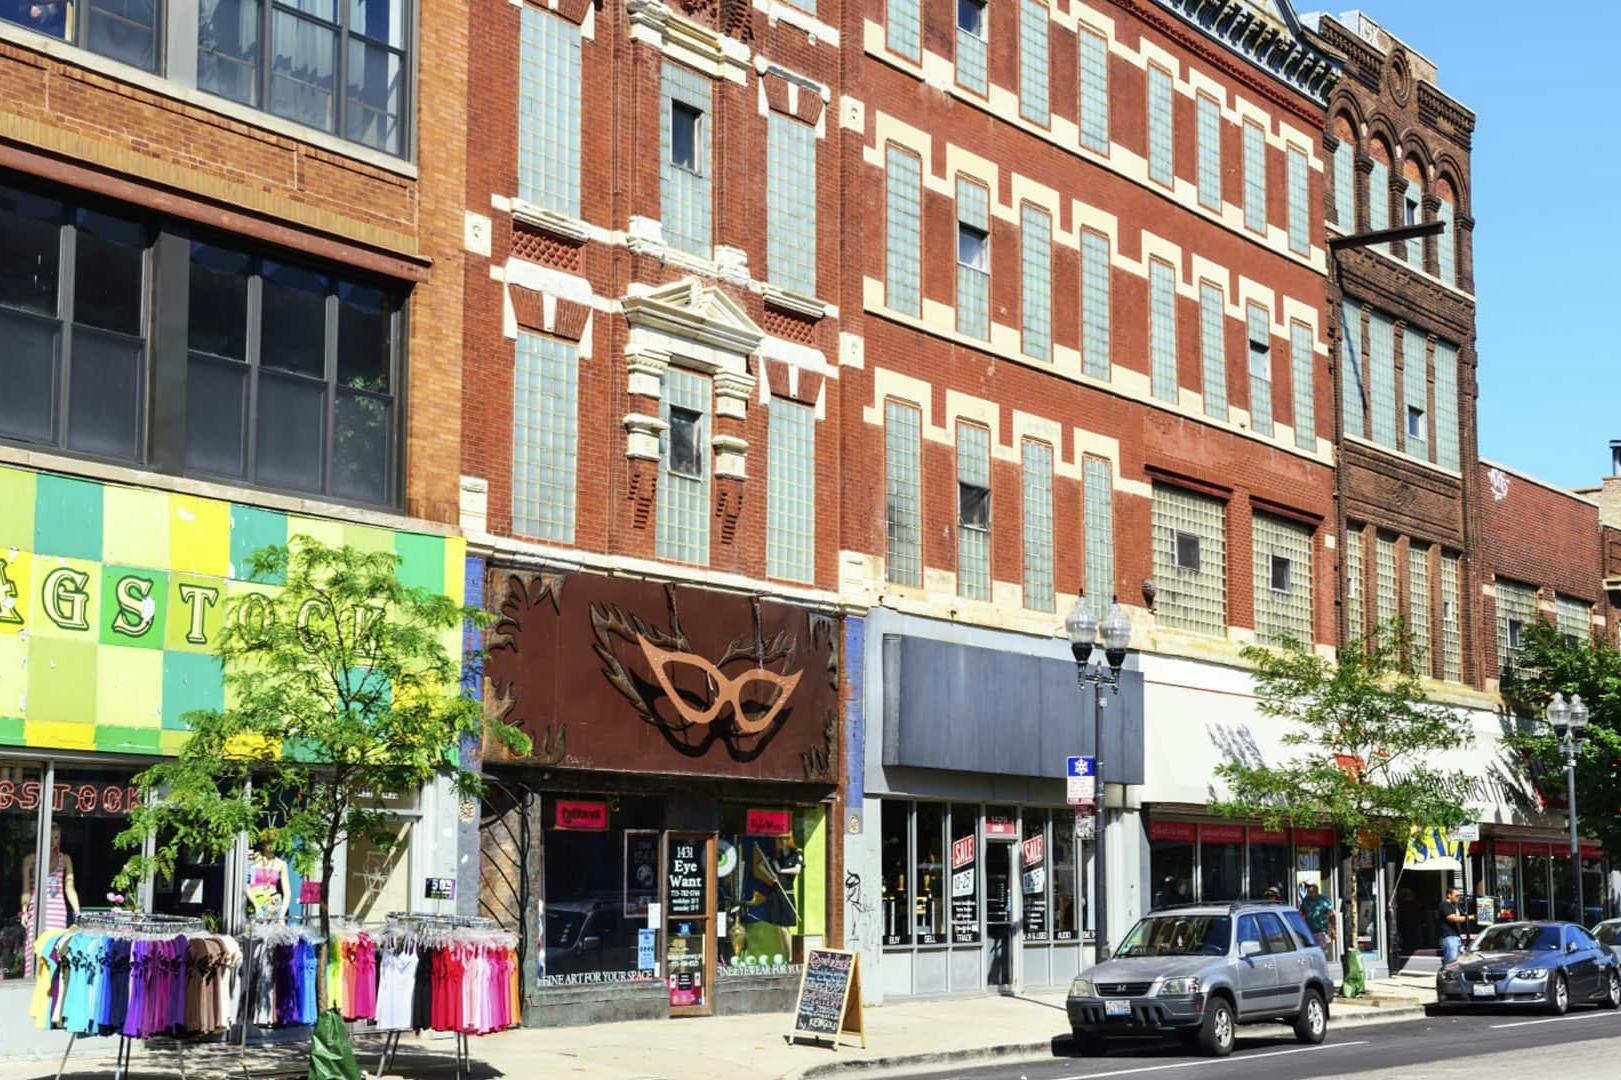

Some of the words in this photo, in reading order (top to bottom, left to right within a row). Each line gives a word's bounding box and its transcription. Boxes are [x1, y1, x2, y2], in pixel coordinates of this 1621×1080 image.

[955, 838, 974, 864] SALE
[1024, 838, 1044, 863] SALE
[674, 859, 698, 874] Eye
[669, 874, 702, 888] Want
[565, 972, 583, 985] ART
[584, 971, 601, 984] FOR
[602, 970, 627, 983] YOUR
